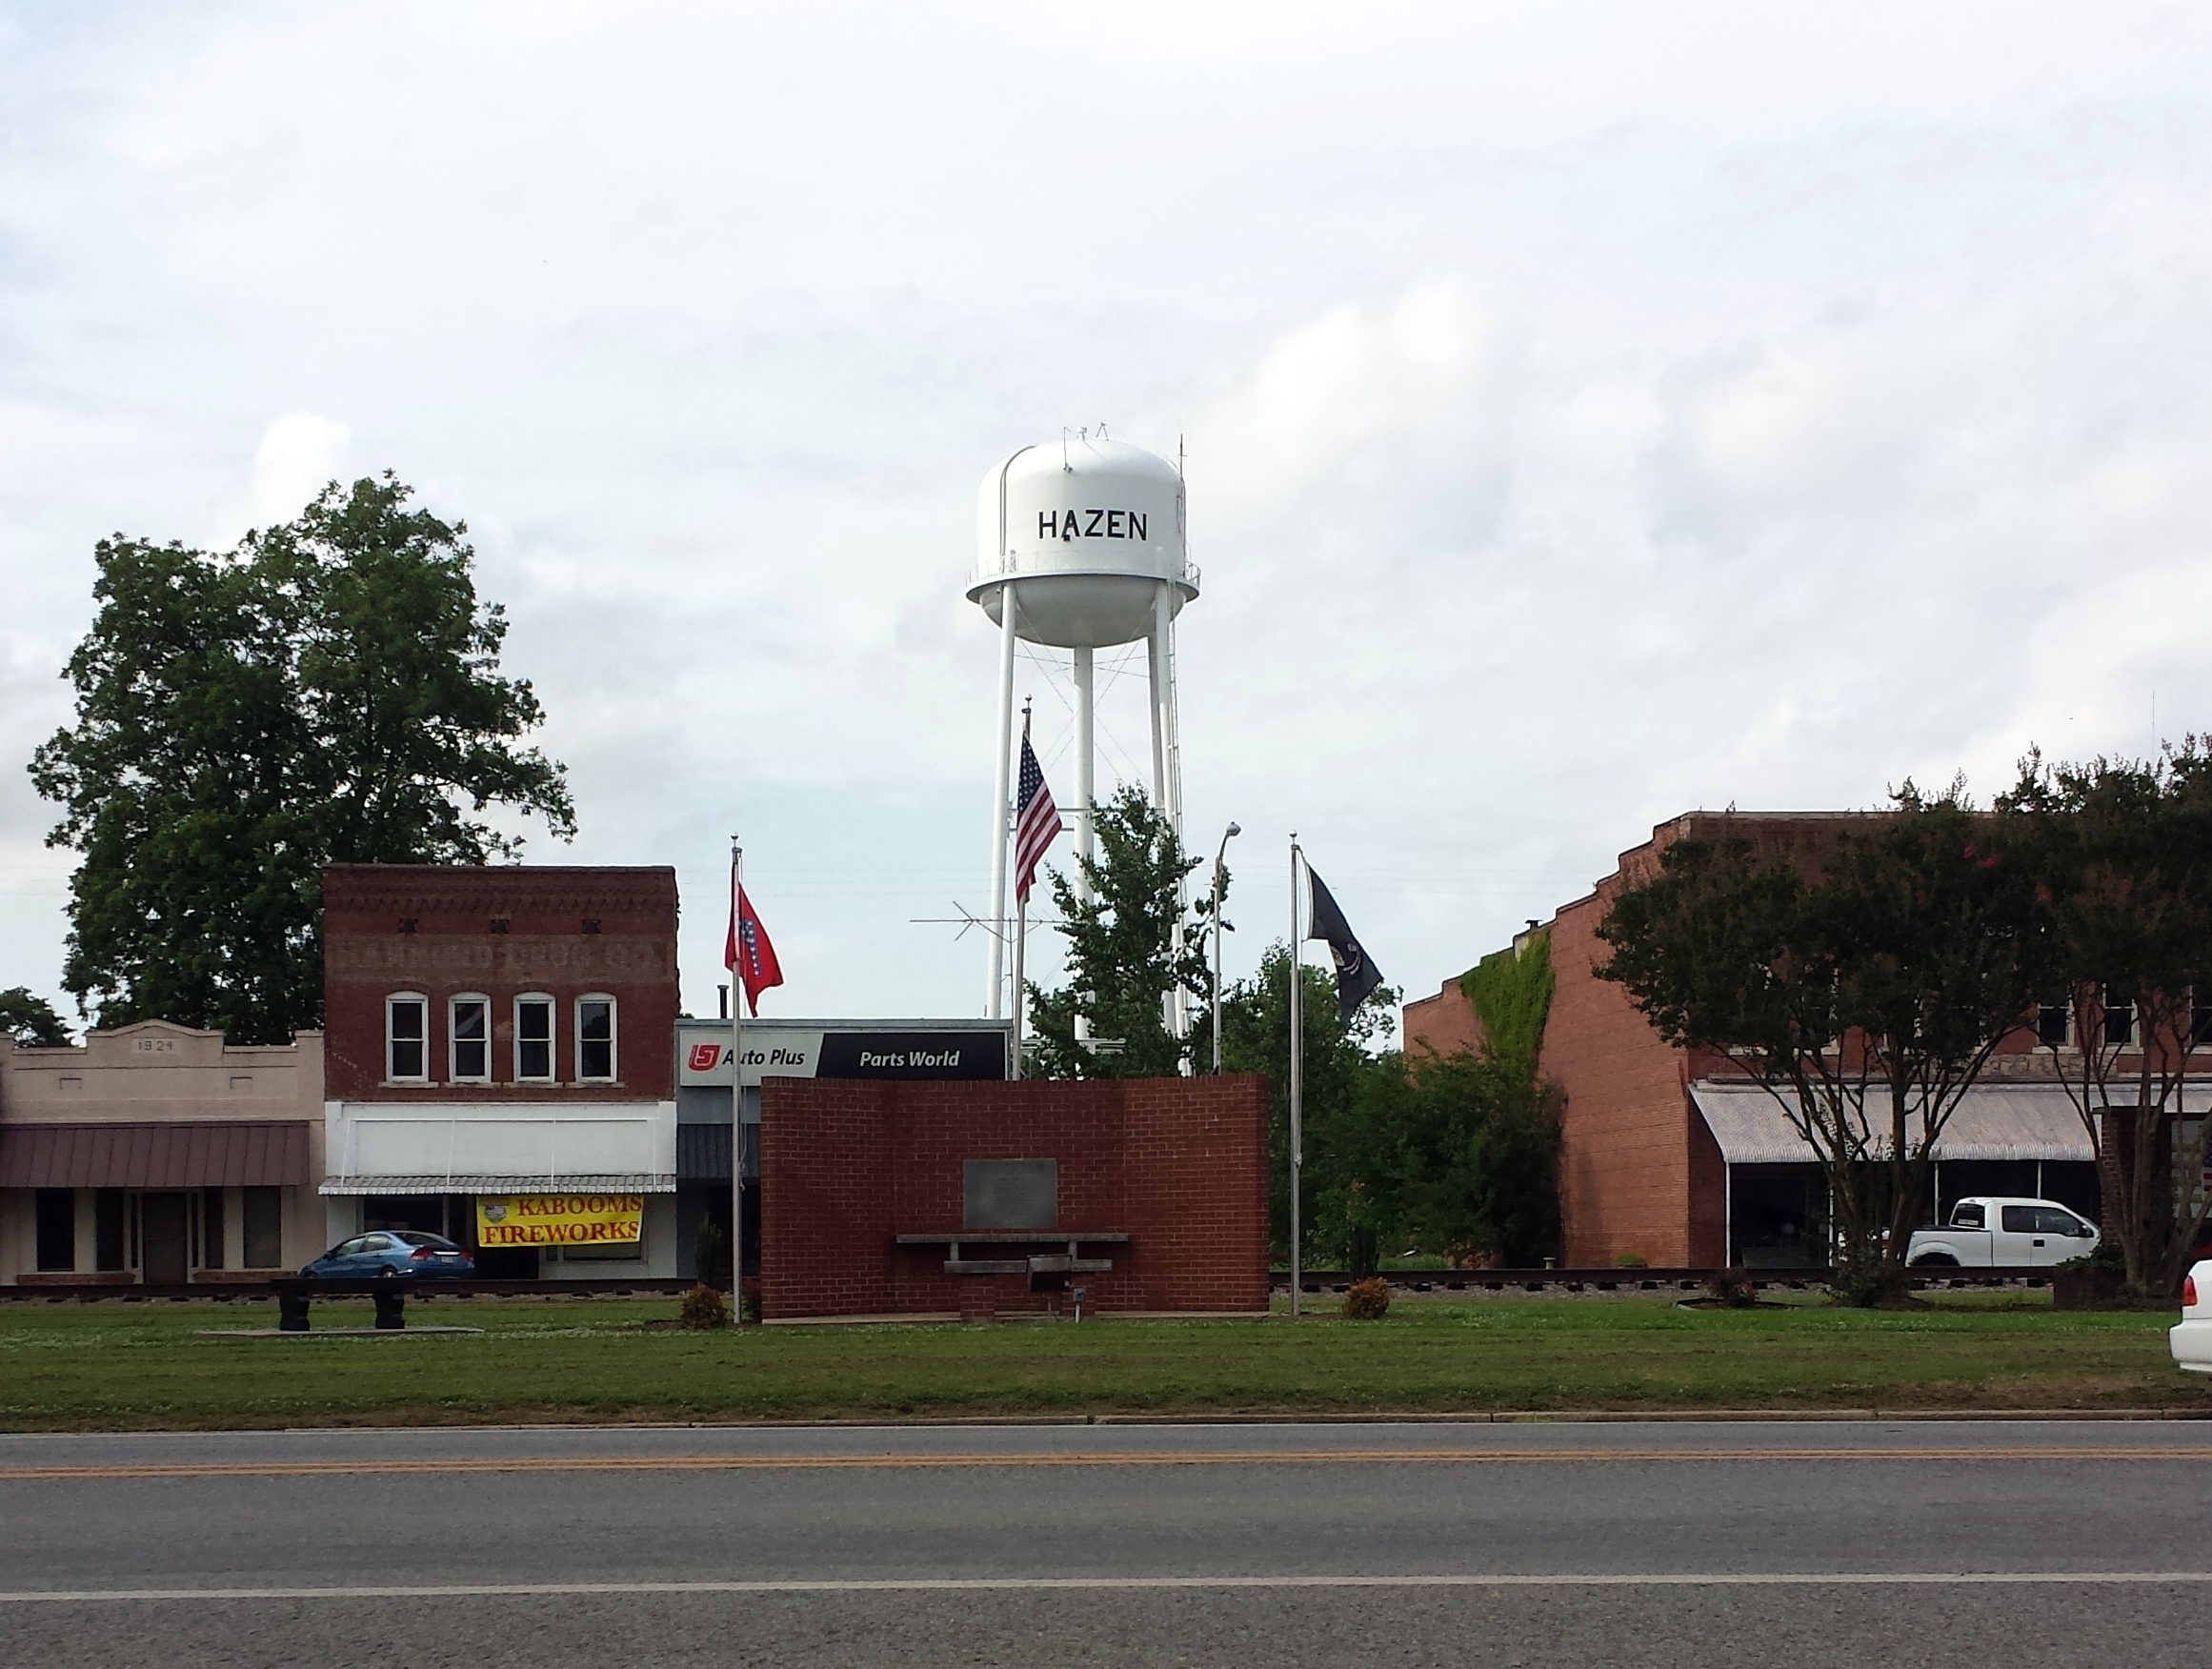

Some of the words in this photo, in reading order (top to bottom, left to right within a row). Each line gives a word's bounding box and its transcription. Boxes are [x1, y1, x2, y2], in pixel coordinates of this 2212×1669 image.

[1038, 509, 1147, 541] HAZEN
[138, 1040, 172, 1051] 1924
[770, 1048, 805, 1065] Plus
[859, 1051, 905, 1067] Parts
[909, 1050, 960, 1067] World
[517, 1195, 642, 1216] KABOOMS
[484, 1220, 639, 1244] FIREWORKS
